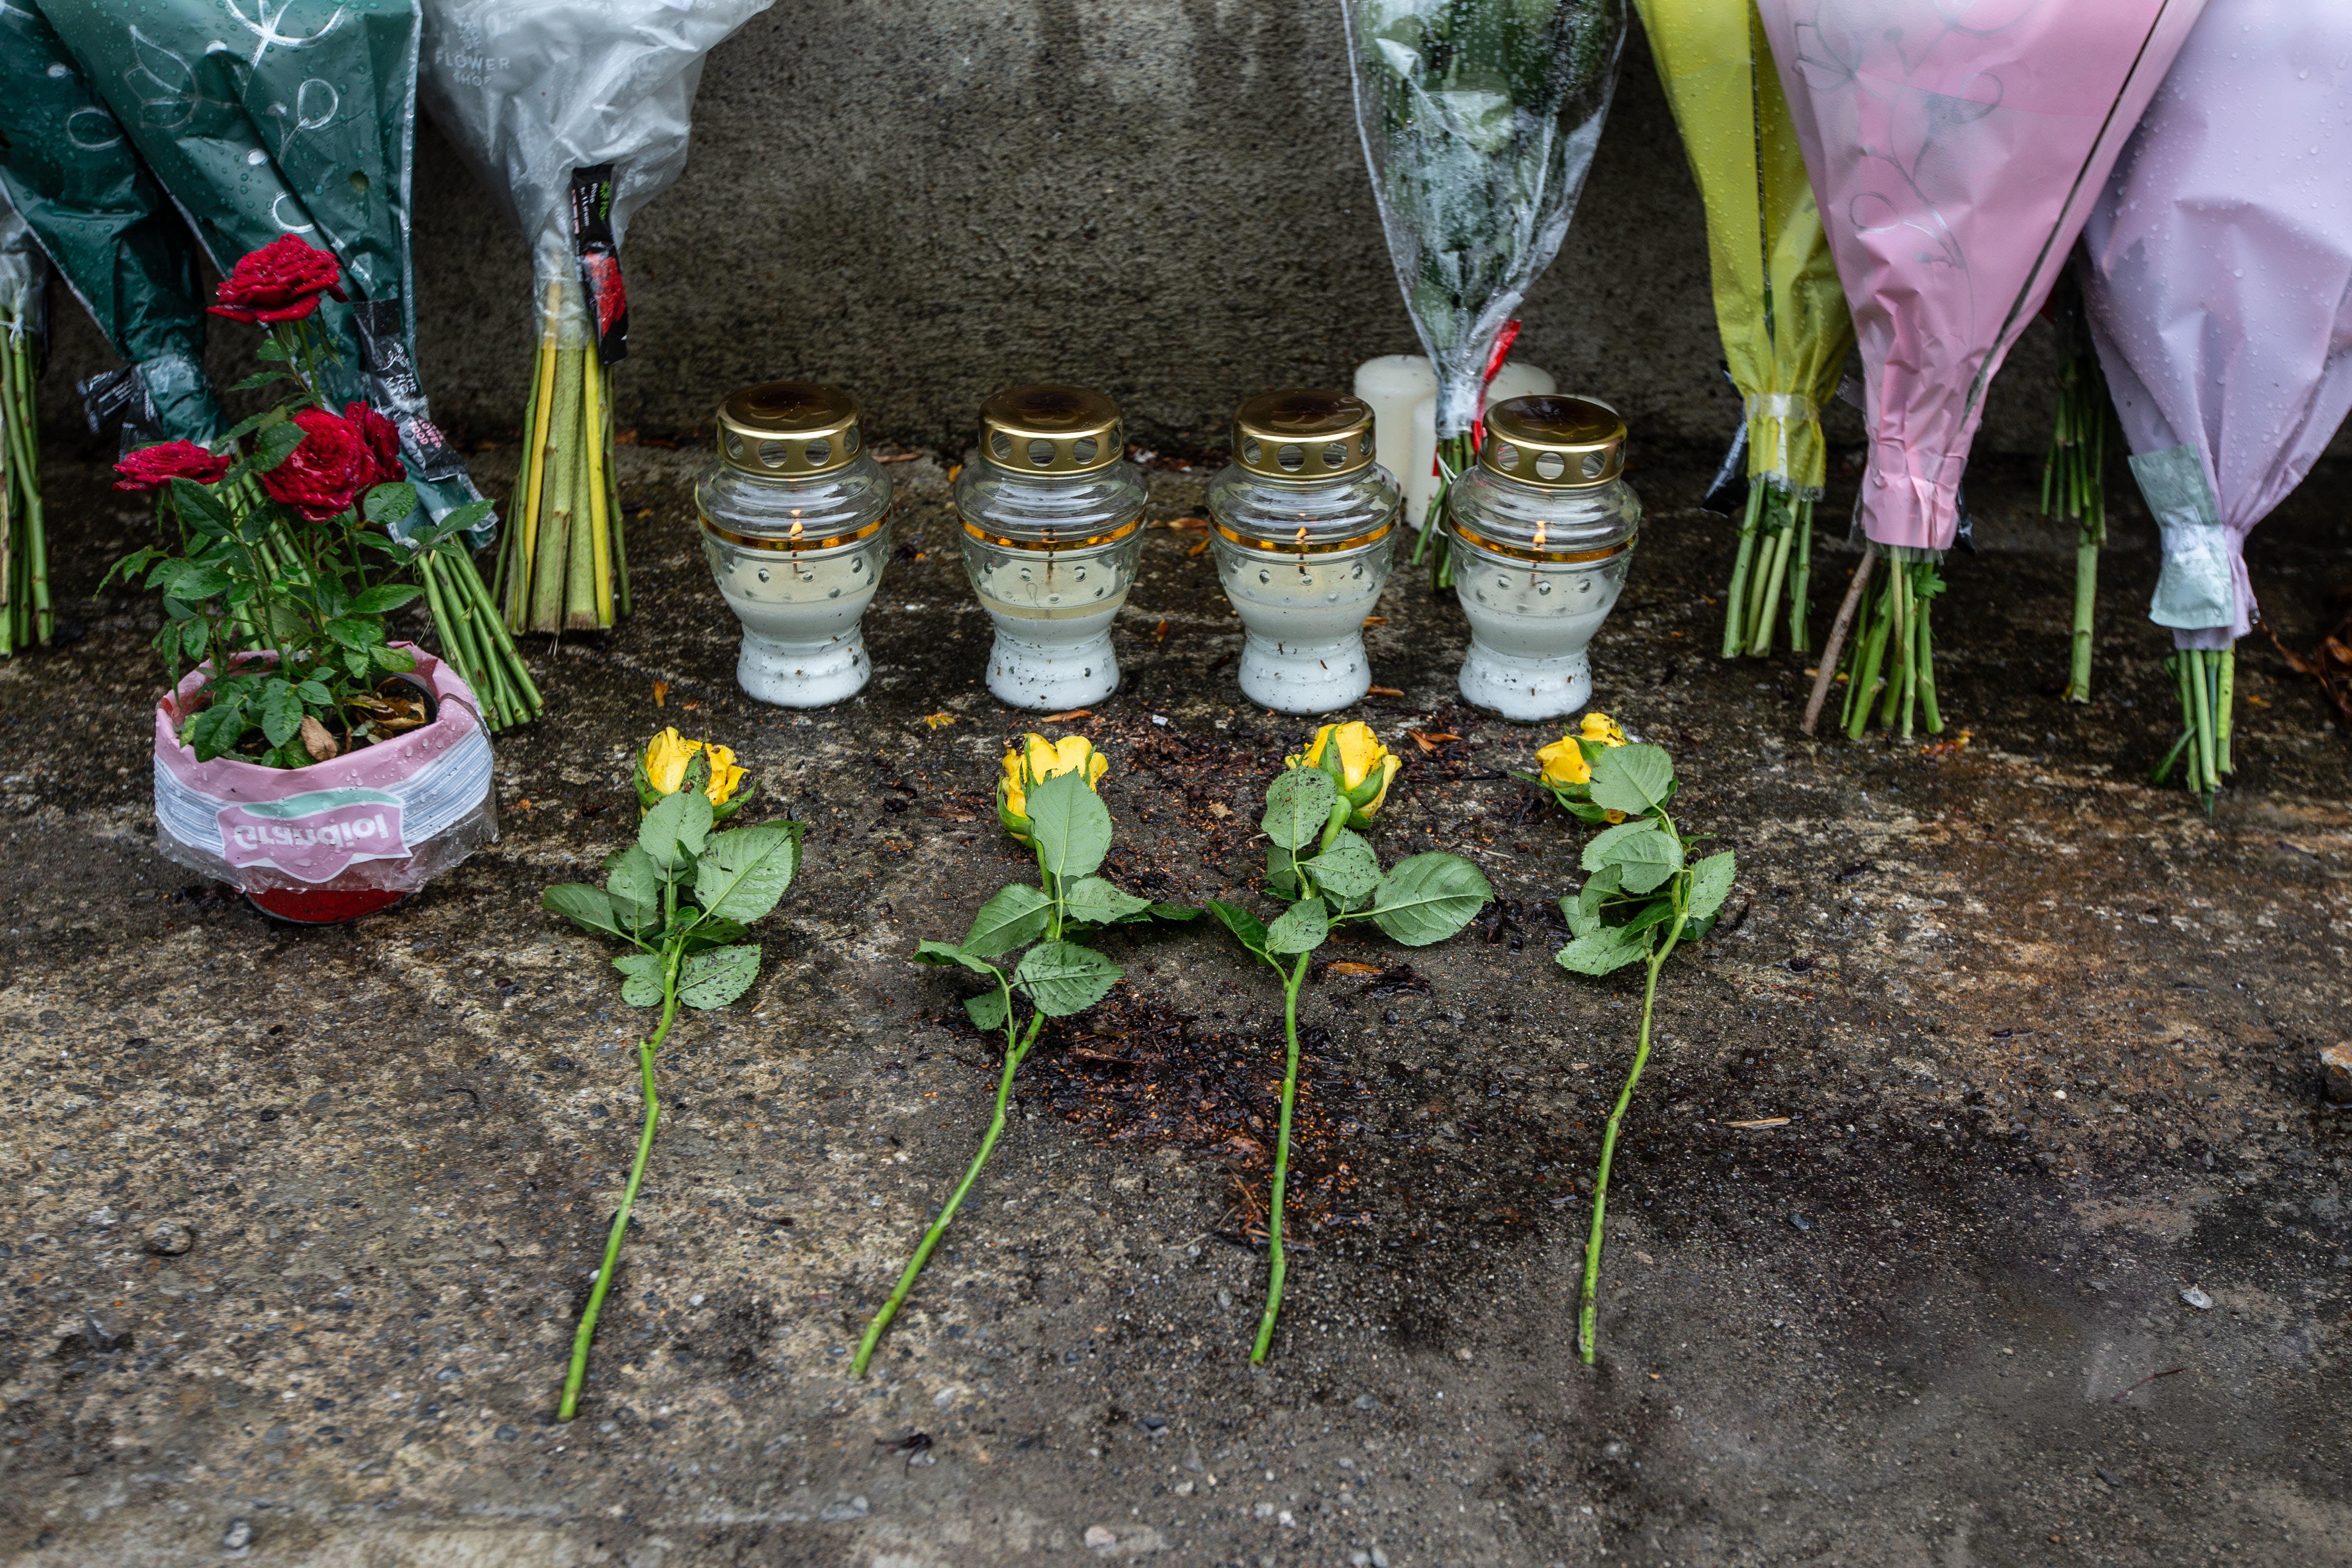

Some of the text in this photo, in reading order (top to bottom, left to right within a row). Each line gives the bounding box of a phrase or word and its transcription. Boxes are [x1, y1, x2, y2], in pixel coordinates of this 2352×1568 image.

[435, 47, 510, 71] FLOWER
[452, 69, 491, 86] SHOP
[408, 421, 429, 445] FOOD
